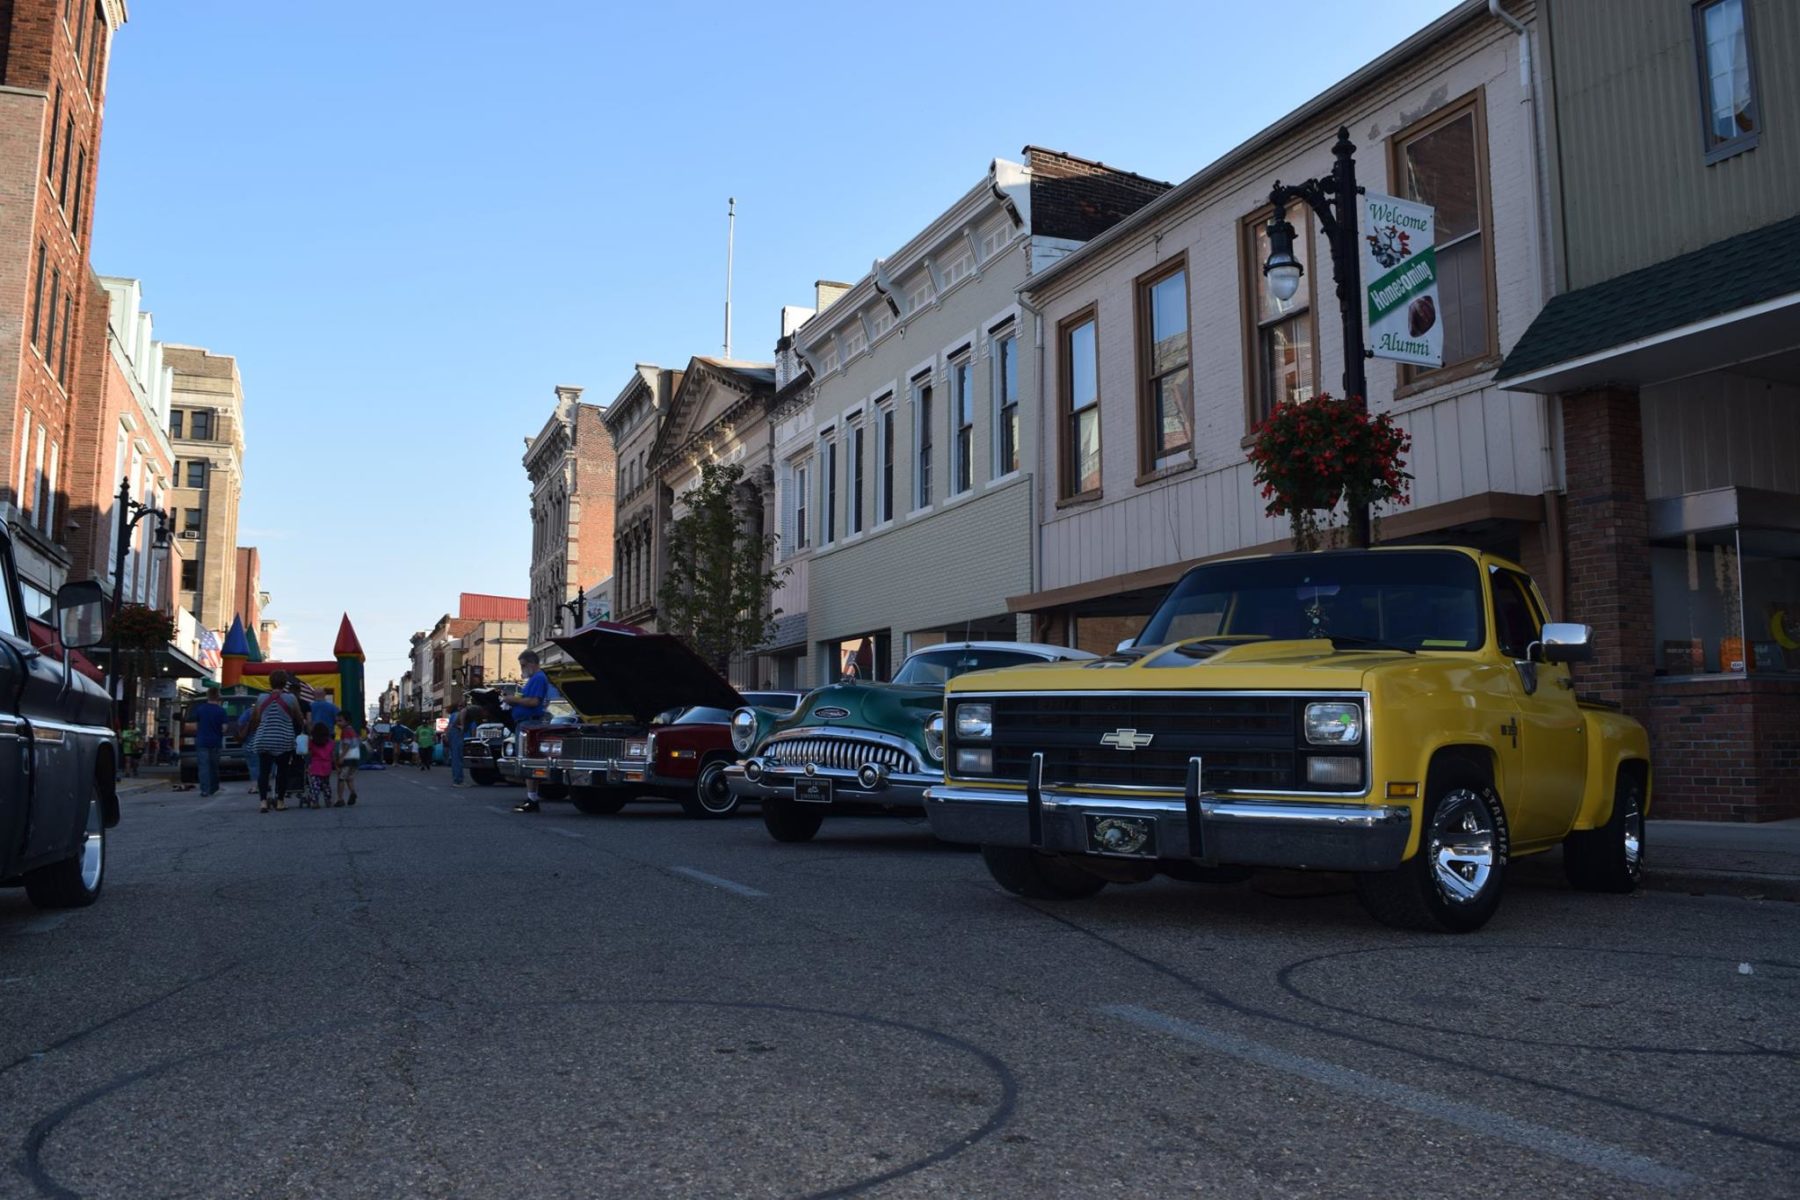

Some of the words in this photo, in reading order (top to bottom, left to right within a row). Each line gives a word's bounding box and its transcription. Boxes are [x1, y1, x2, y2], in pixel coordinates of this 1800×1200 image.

[1369, 203, 1428, 232] Welcome
[1370, 260, 1434, 311] Homecoming
[1379, 333, 1431, 356] Alumni
